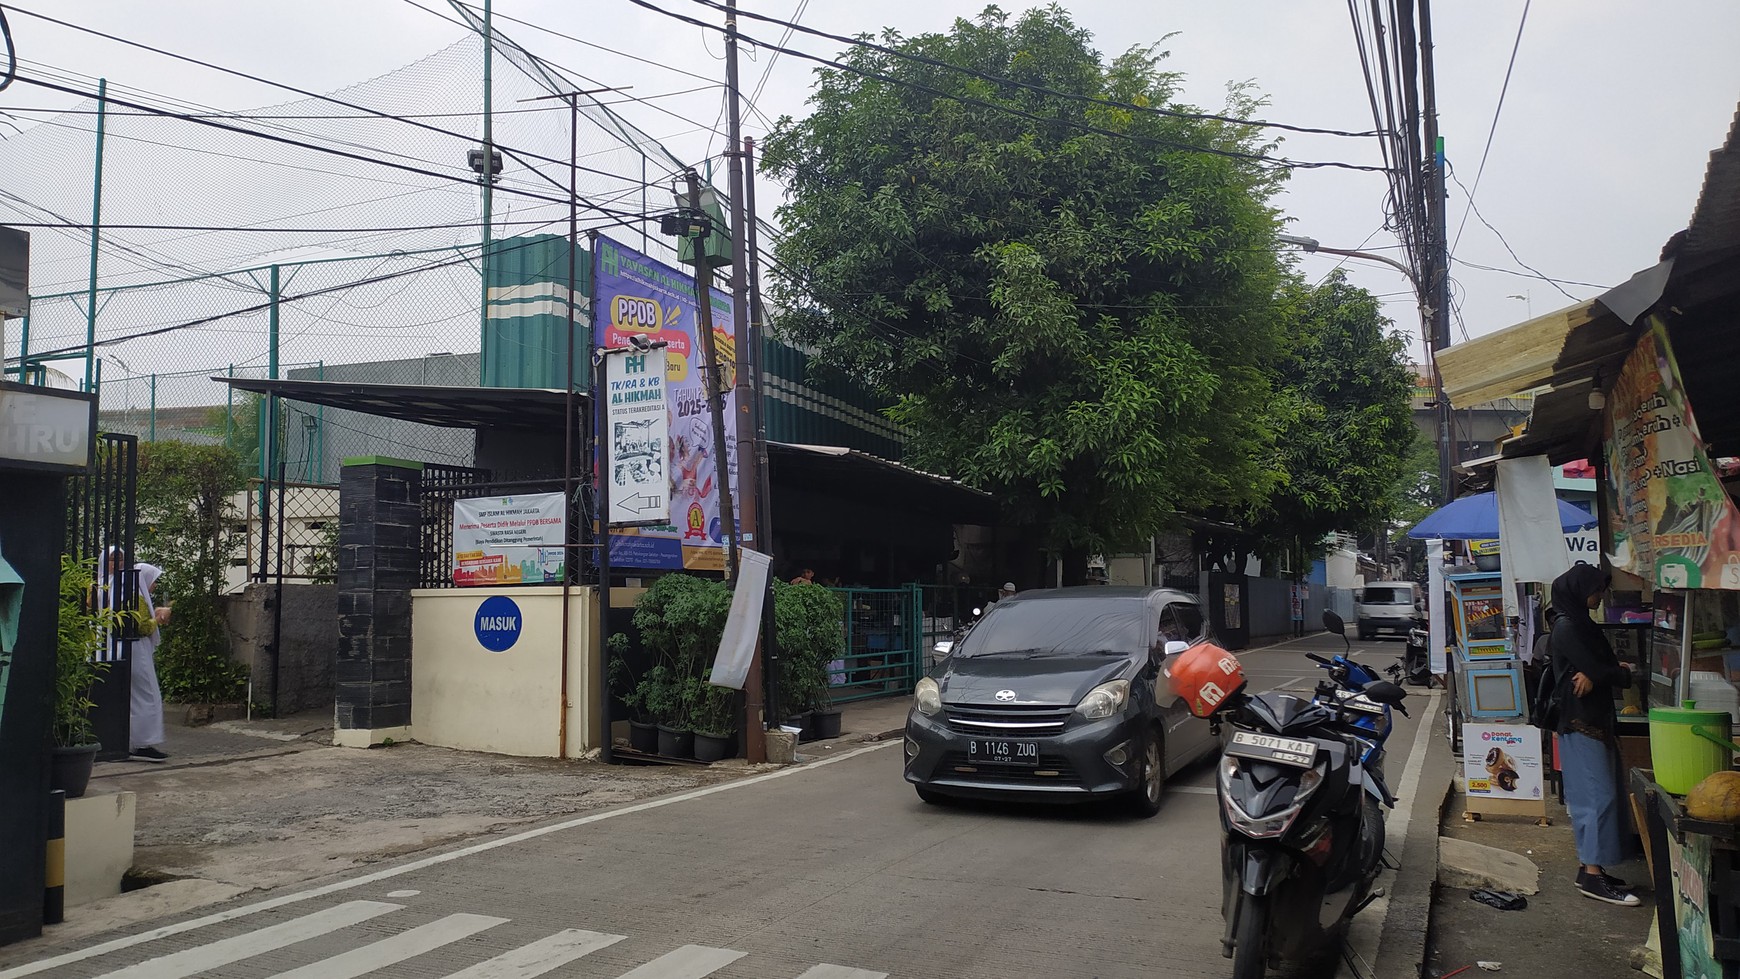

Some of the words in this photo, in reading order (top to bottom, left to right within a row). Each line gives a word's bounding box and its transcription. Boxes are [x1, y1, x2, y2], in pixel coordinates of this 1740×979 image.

[620, 255, 659, 284] YAYASAN
[660, 272, 670, 287] AL
[618, 298, 656, 328] PPDB
[660, 336, 685, 349] Pserta
[611, 380, 637, 391] TK/RA
[640, 378, 646, 388] &
[648, 376, 660, 387] KB
[612, 393, 623, 404] AL
[624, 389, 661, 403] HIKMAH
[612, 407, 628, 416] STATUS
[628, 405, 660, 414] TERAKREDITASI
[506, 508, 522, 516] HIKMAH
[480, 521, 497, 529] Peserta
[497, 520, 509, 528] Didik
[509, 519, 526, 527] Melalui
[526, 518, 539, 526] PPDB
[539, 517, 562, 525] BERSAMA
[1566, 537, 1598, 552] Wa
[1653, 532, 1707, 547] RSEDIA
[480, 616, 517, 631] MASUK
[970, 741, 977, 754] B
[985, 741, 1009, 755] 1146
[1016, 743, 1036, 757] ZUQ
[1235, 733, 1243, 743] B
[1251, 735, 1281, 748] 5071
[1287, 741, 1312, 753] KAT
